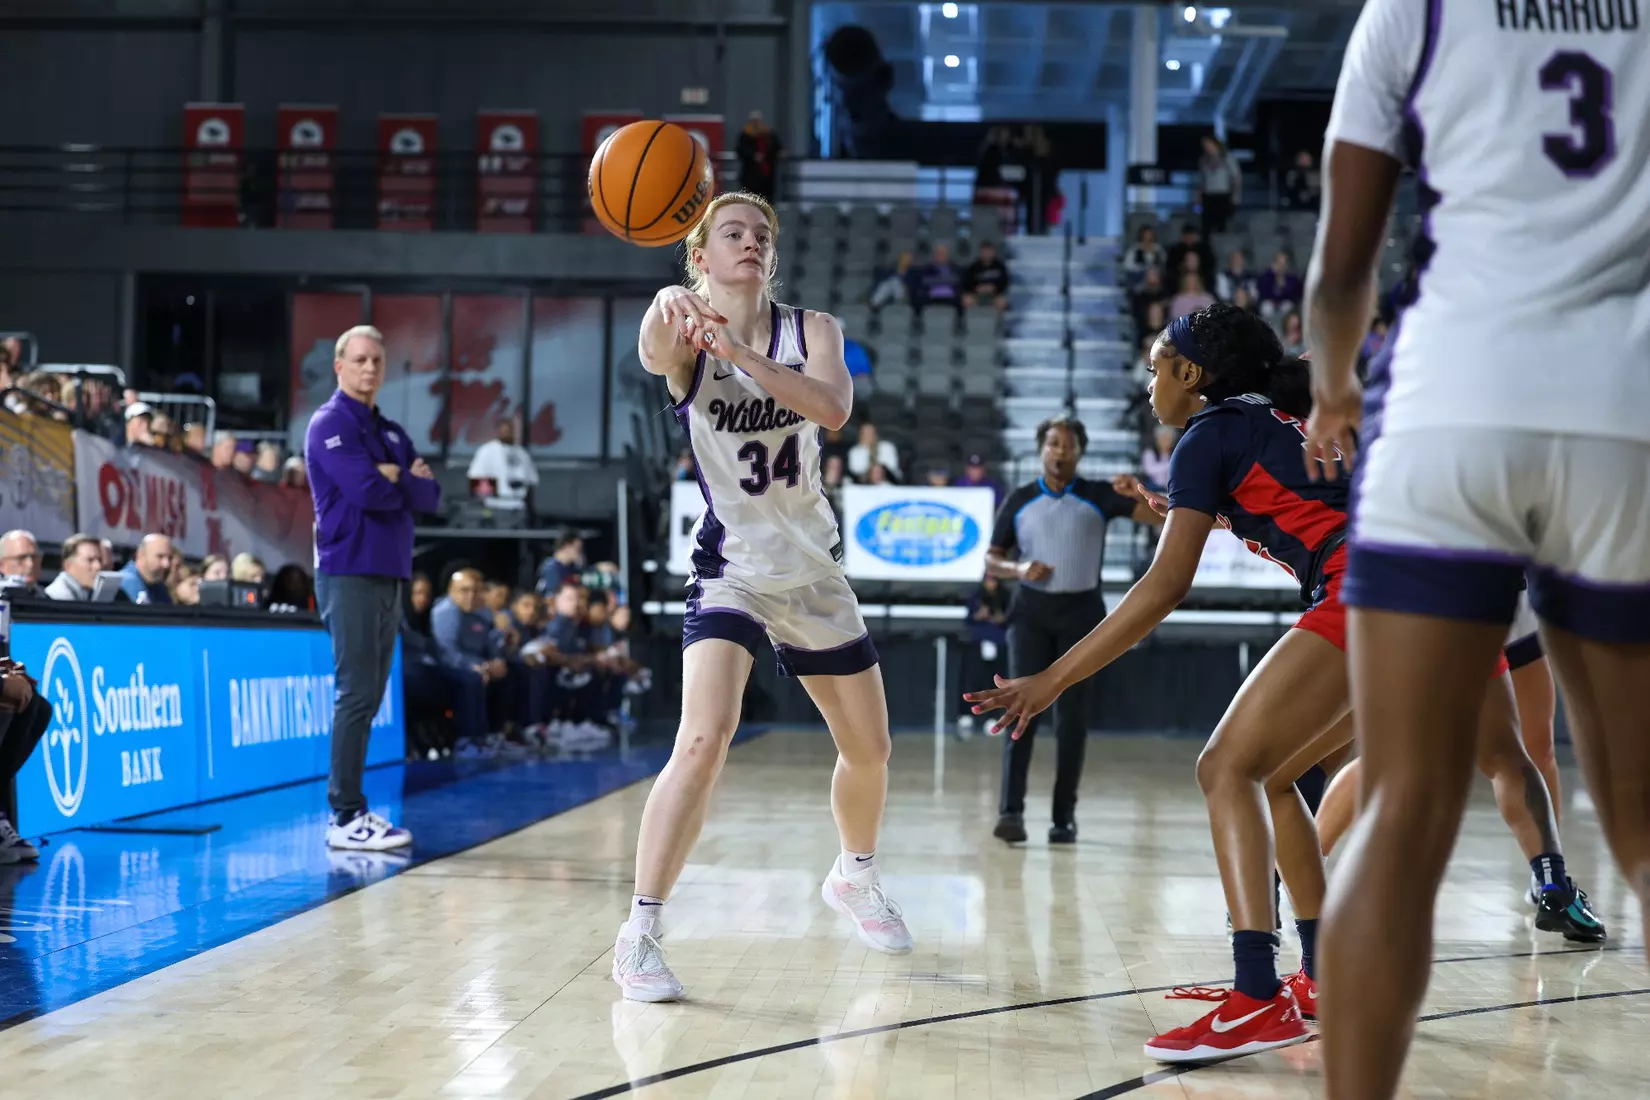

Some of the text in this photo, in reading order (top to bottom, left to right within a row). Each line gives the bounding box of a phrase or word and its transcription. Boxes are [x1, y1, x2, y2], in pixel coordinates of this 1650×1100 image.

[1496, 0, 1639, 31] HARROD
[1539, 50, 1616, 179] 3
[737, 433, 801, 496] 34
[91, 661, 183, 736] Southern
[121, 746, 163, 787] BANK
